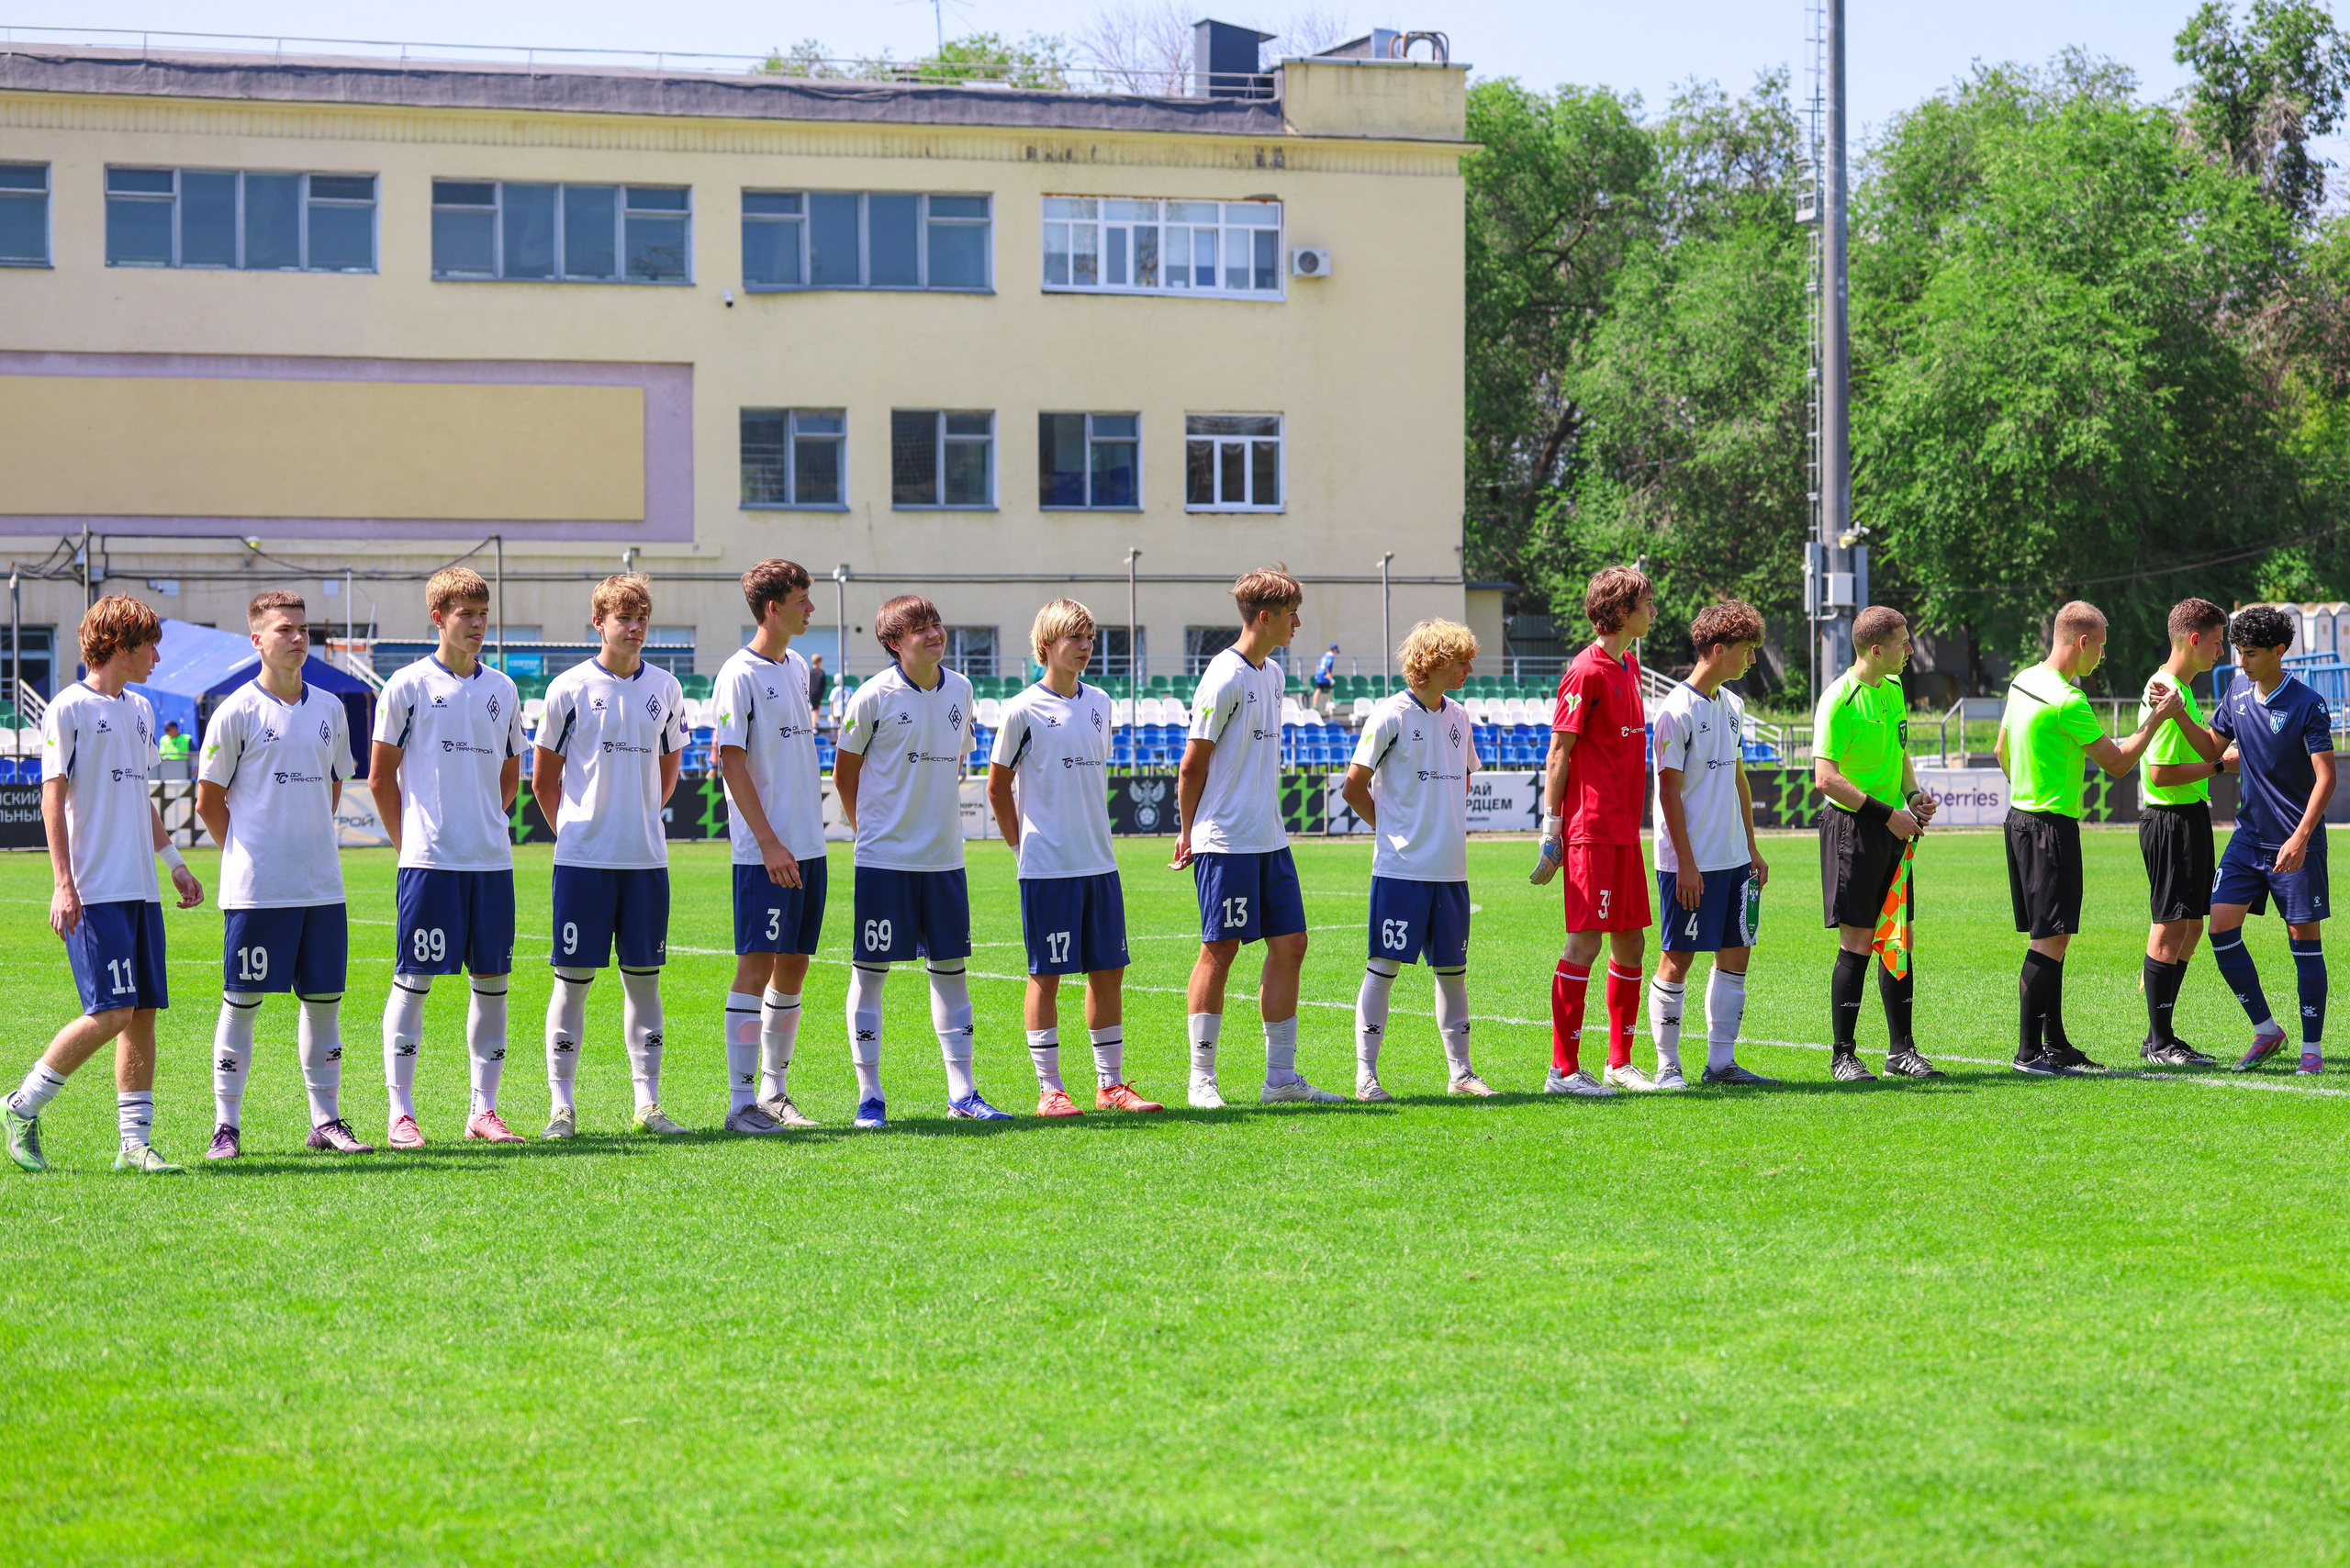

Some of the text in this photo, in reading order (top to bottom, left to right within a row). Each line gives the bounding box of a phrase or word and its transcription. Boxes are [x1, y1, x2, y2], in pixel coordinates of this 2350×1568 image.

[0, 789, 42, 806] СКИЙ
[1930, 787, 1998, 807] berries
[765, 908, 781, 941] 3
[1222, 897, 1248, 928] 13
[1684, 913, 1699, 941] 4
[413, 927, 446, 962] 89
[563, 922, 578, 955] 9
[864, 919, 892, 952] 69
[1046, 931, 1070, 963] 17
[1382, 918, 1408, 950] 63
[107, 958, 137, 994] 11
[237, 946, 268, 981] 19
